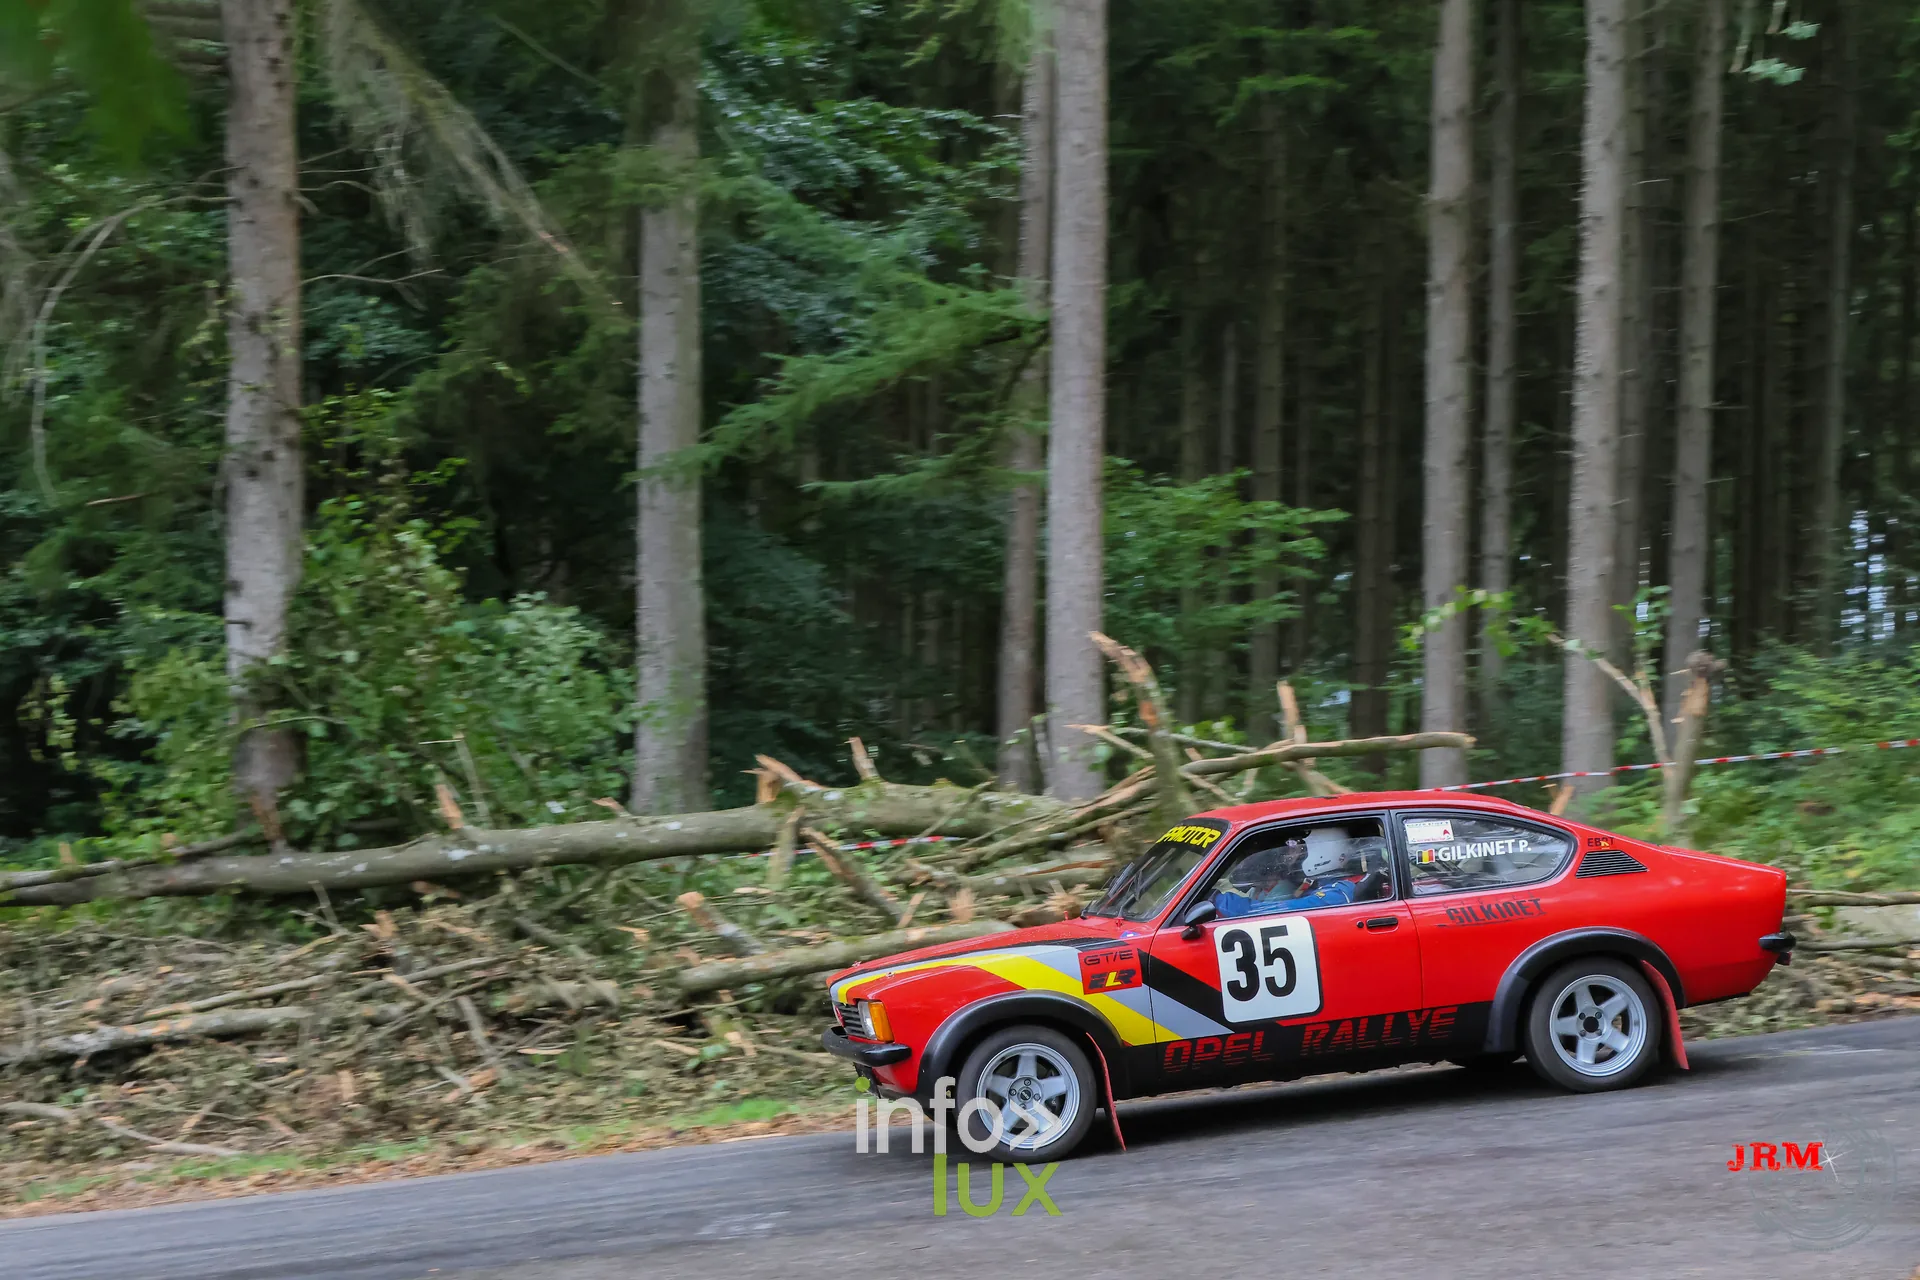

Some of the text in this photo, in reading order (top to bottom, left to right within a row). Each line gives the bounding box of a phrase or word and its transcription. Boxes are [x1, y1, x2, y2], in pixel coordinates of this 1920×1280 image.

[1438, 838, 1516, 862] GILKINET
[1083, 949, 1134, 966] GT/E
[1221, 925, 1297, 1002] 35
[1163, 1007, 1458, 1073] OPEL RALLYE
